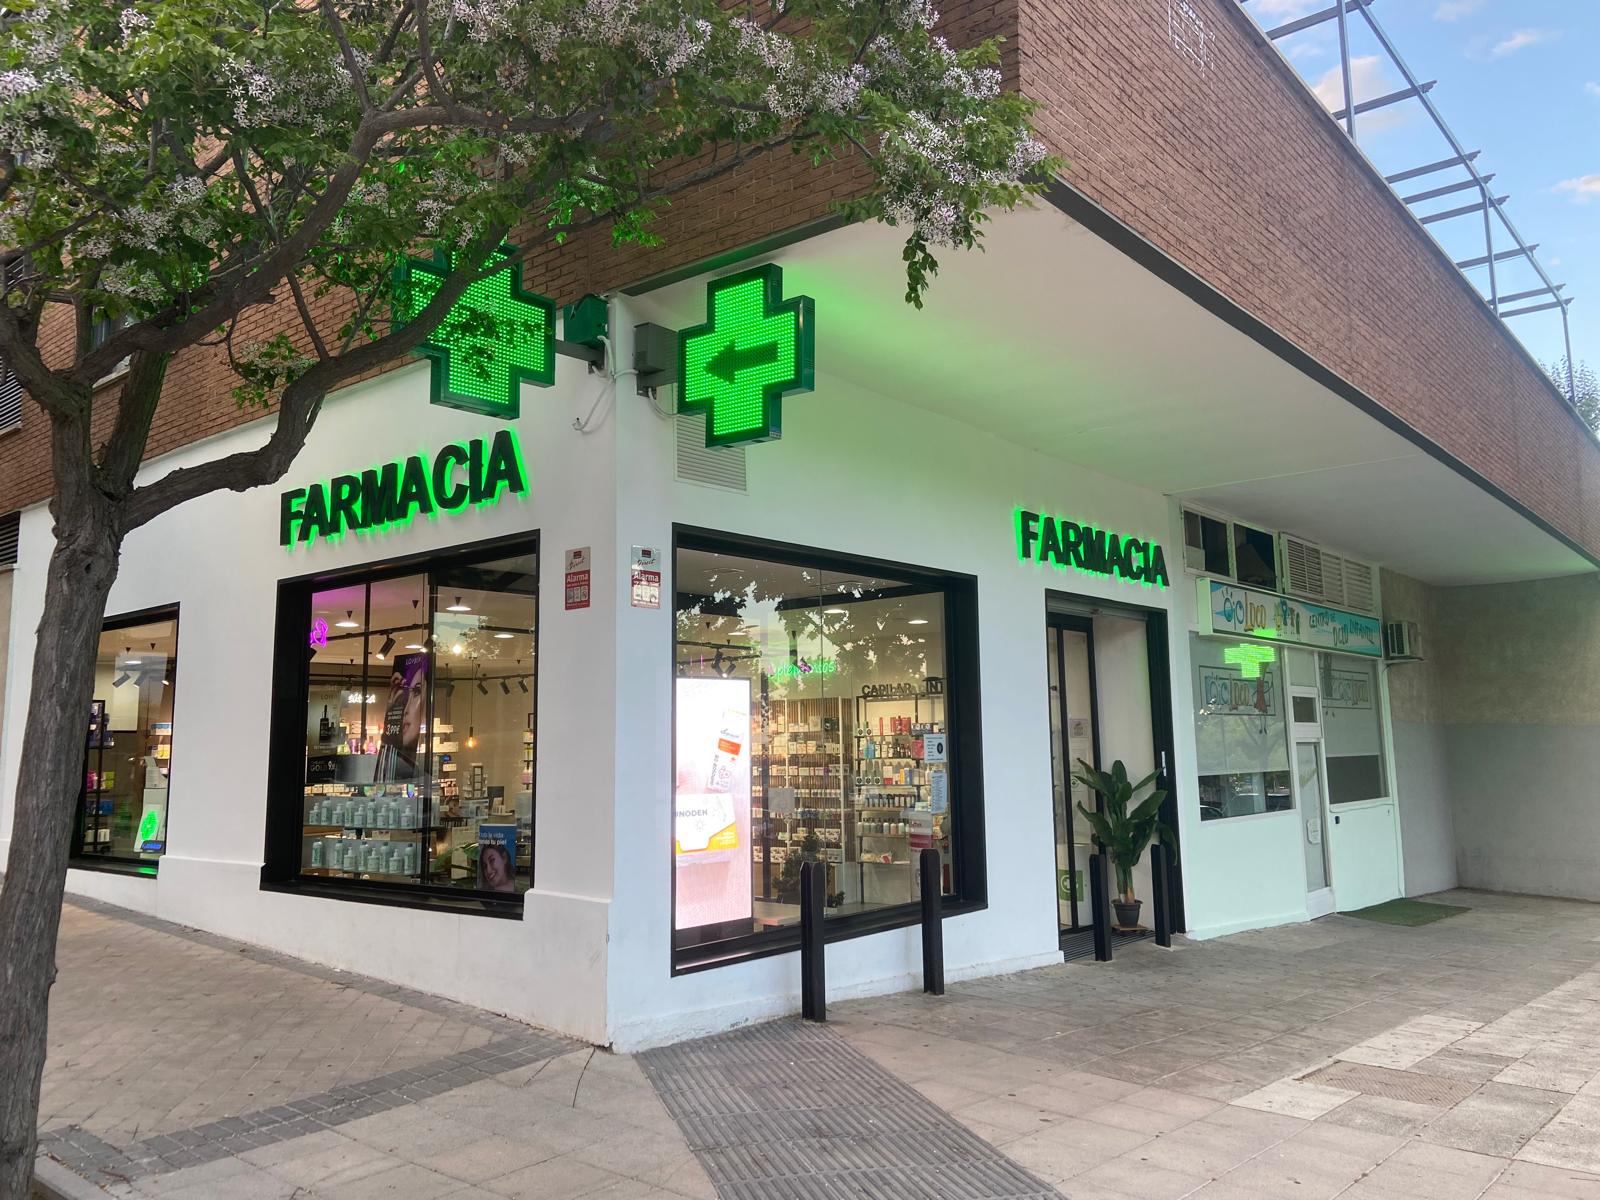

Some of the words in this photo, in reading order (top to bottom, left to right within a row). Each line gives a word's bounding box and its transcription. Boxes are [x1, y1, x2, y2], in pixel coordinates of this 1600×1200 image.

[280, 430, 525, 546] FARMACIA
[1019, 510, 1170, 587] FARMACIA
[567, 573, 589, 582] Alarma
[633, 572, 659, 582] Alarma
